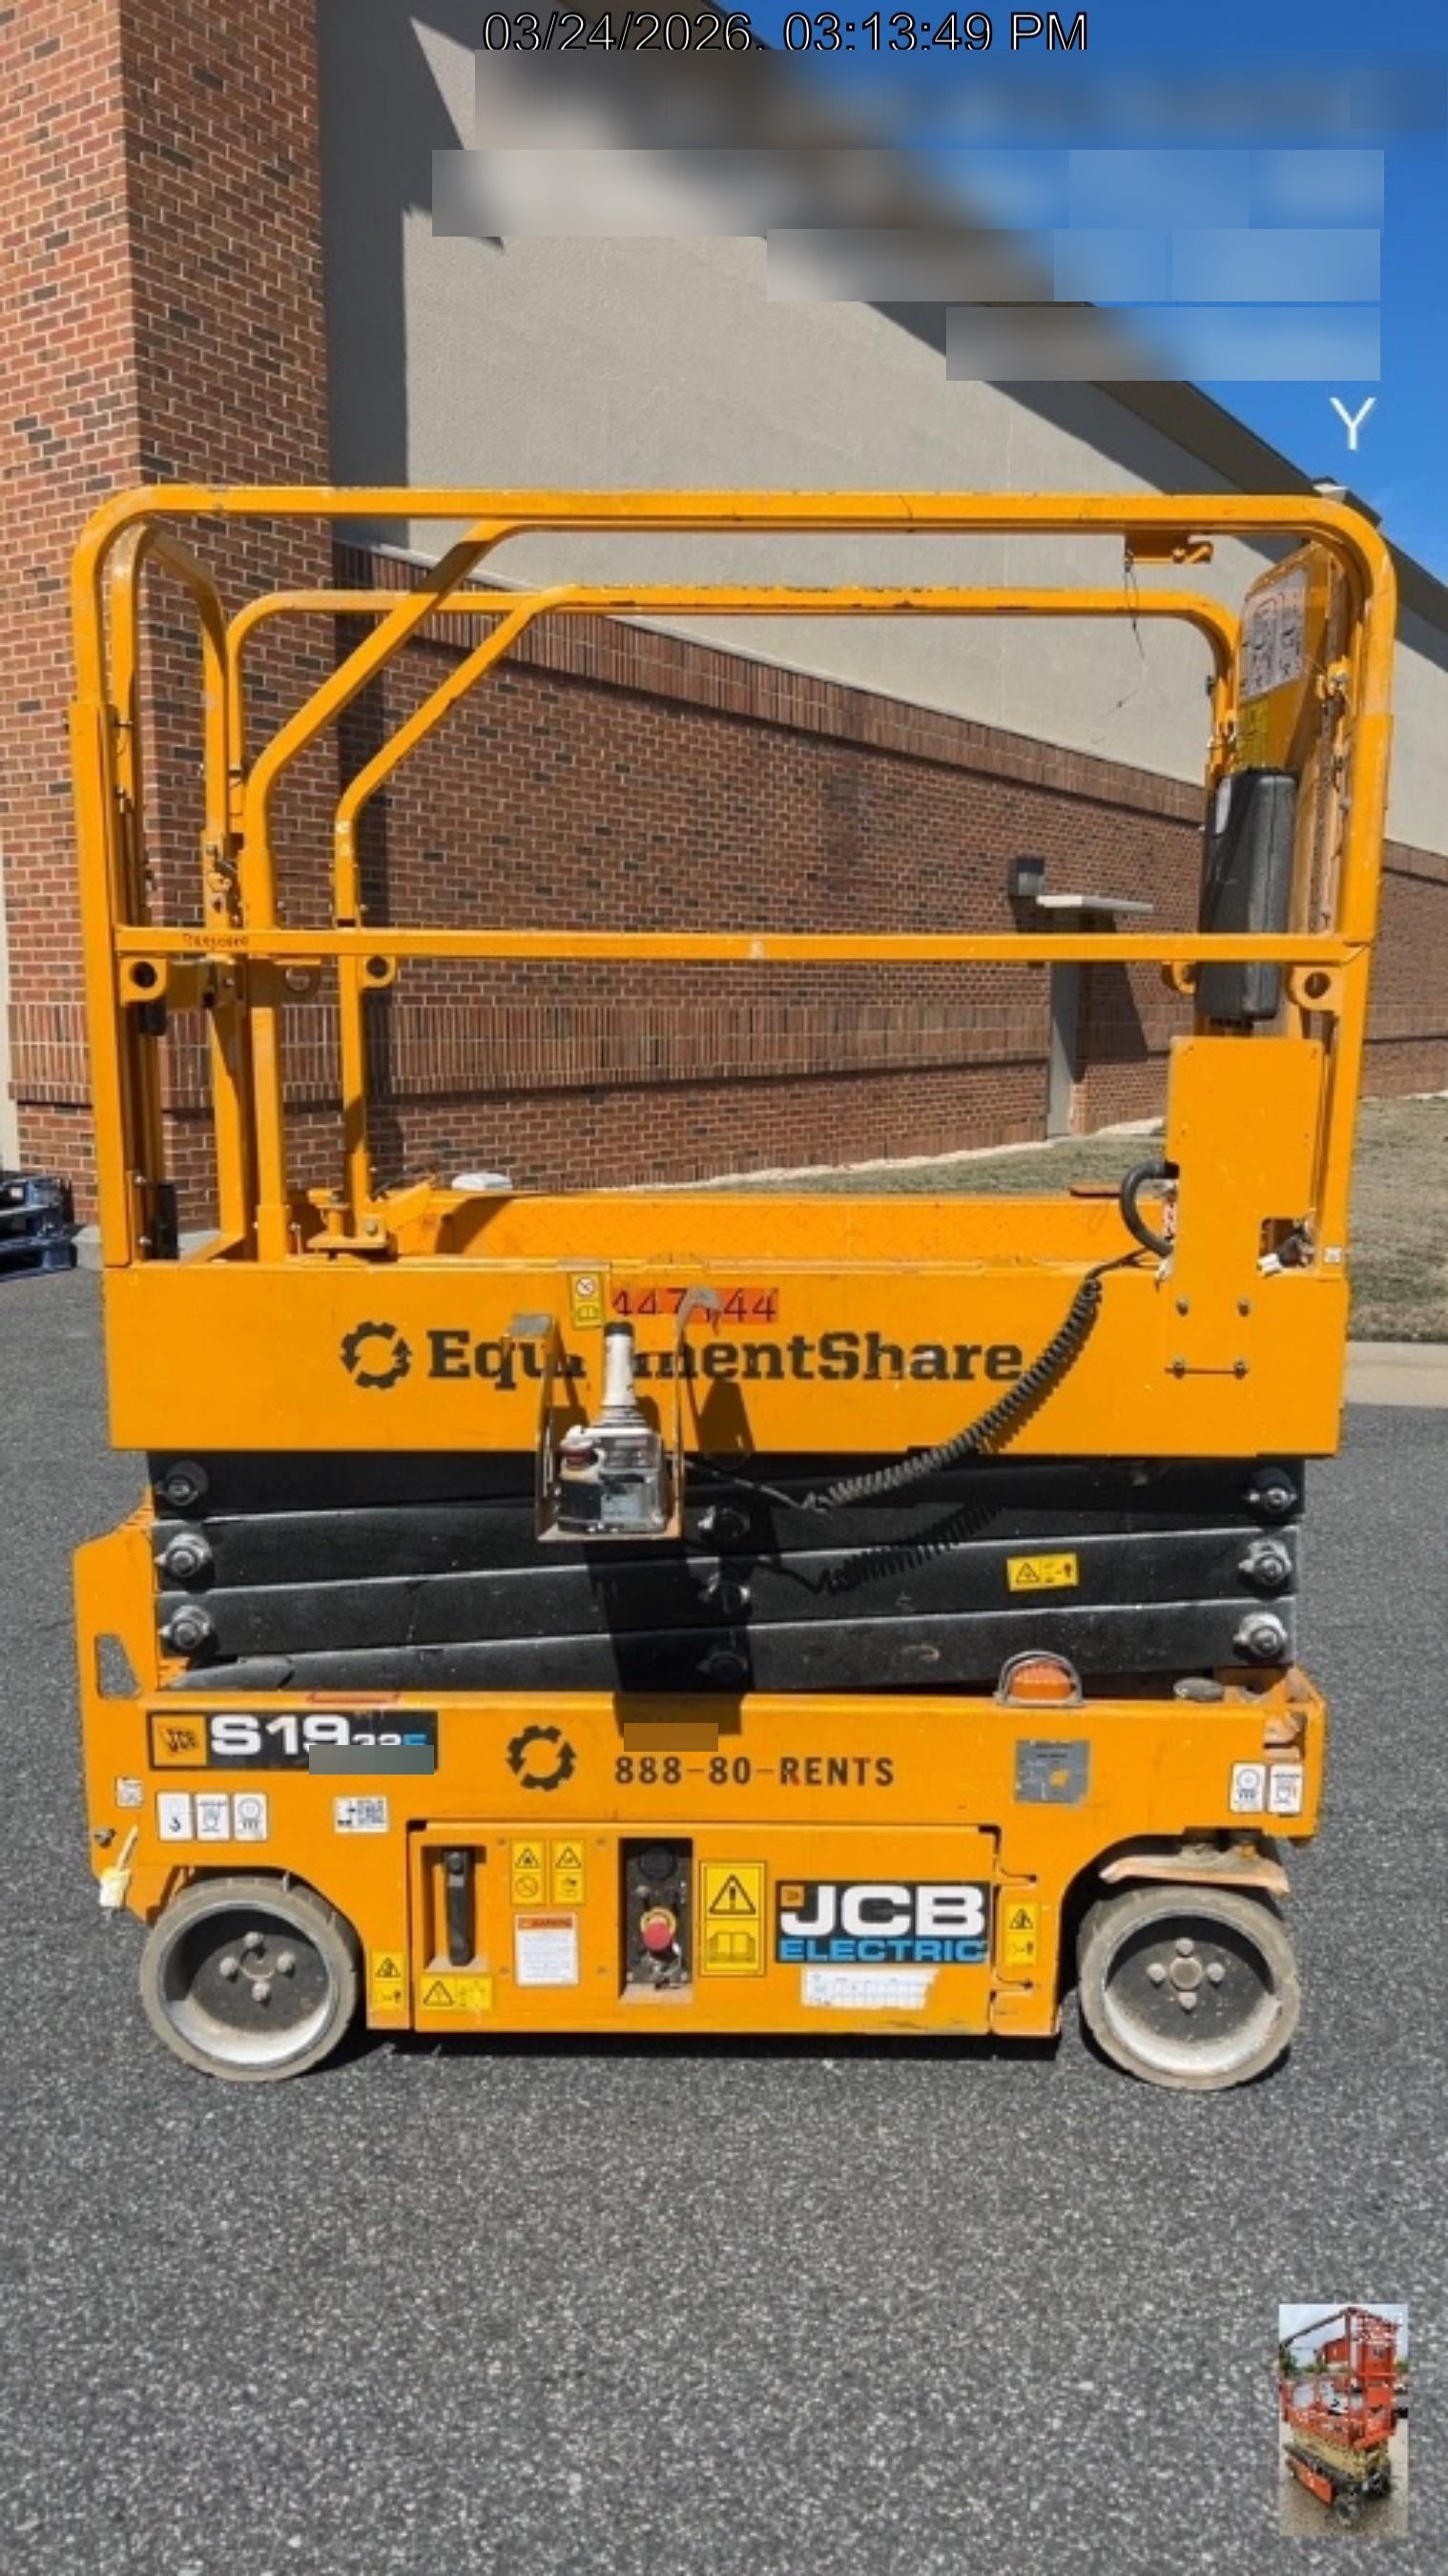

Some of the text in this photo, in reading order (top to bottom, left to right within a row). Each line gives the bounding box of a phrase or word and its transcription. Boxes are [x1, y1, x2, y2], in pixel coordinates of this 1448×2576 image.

[611, 1288, 778, 1323] 44744
[614, 1756, 895, 1786] 888-80-RENTS
[780, 1885, 985, 1936] JCB
[779, 1939, 988, 1962] ELECTRIC
